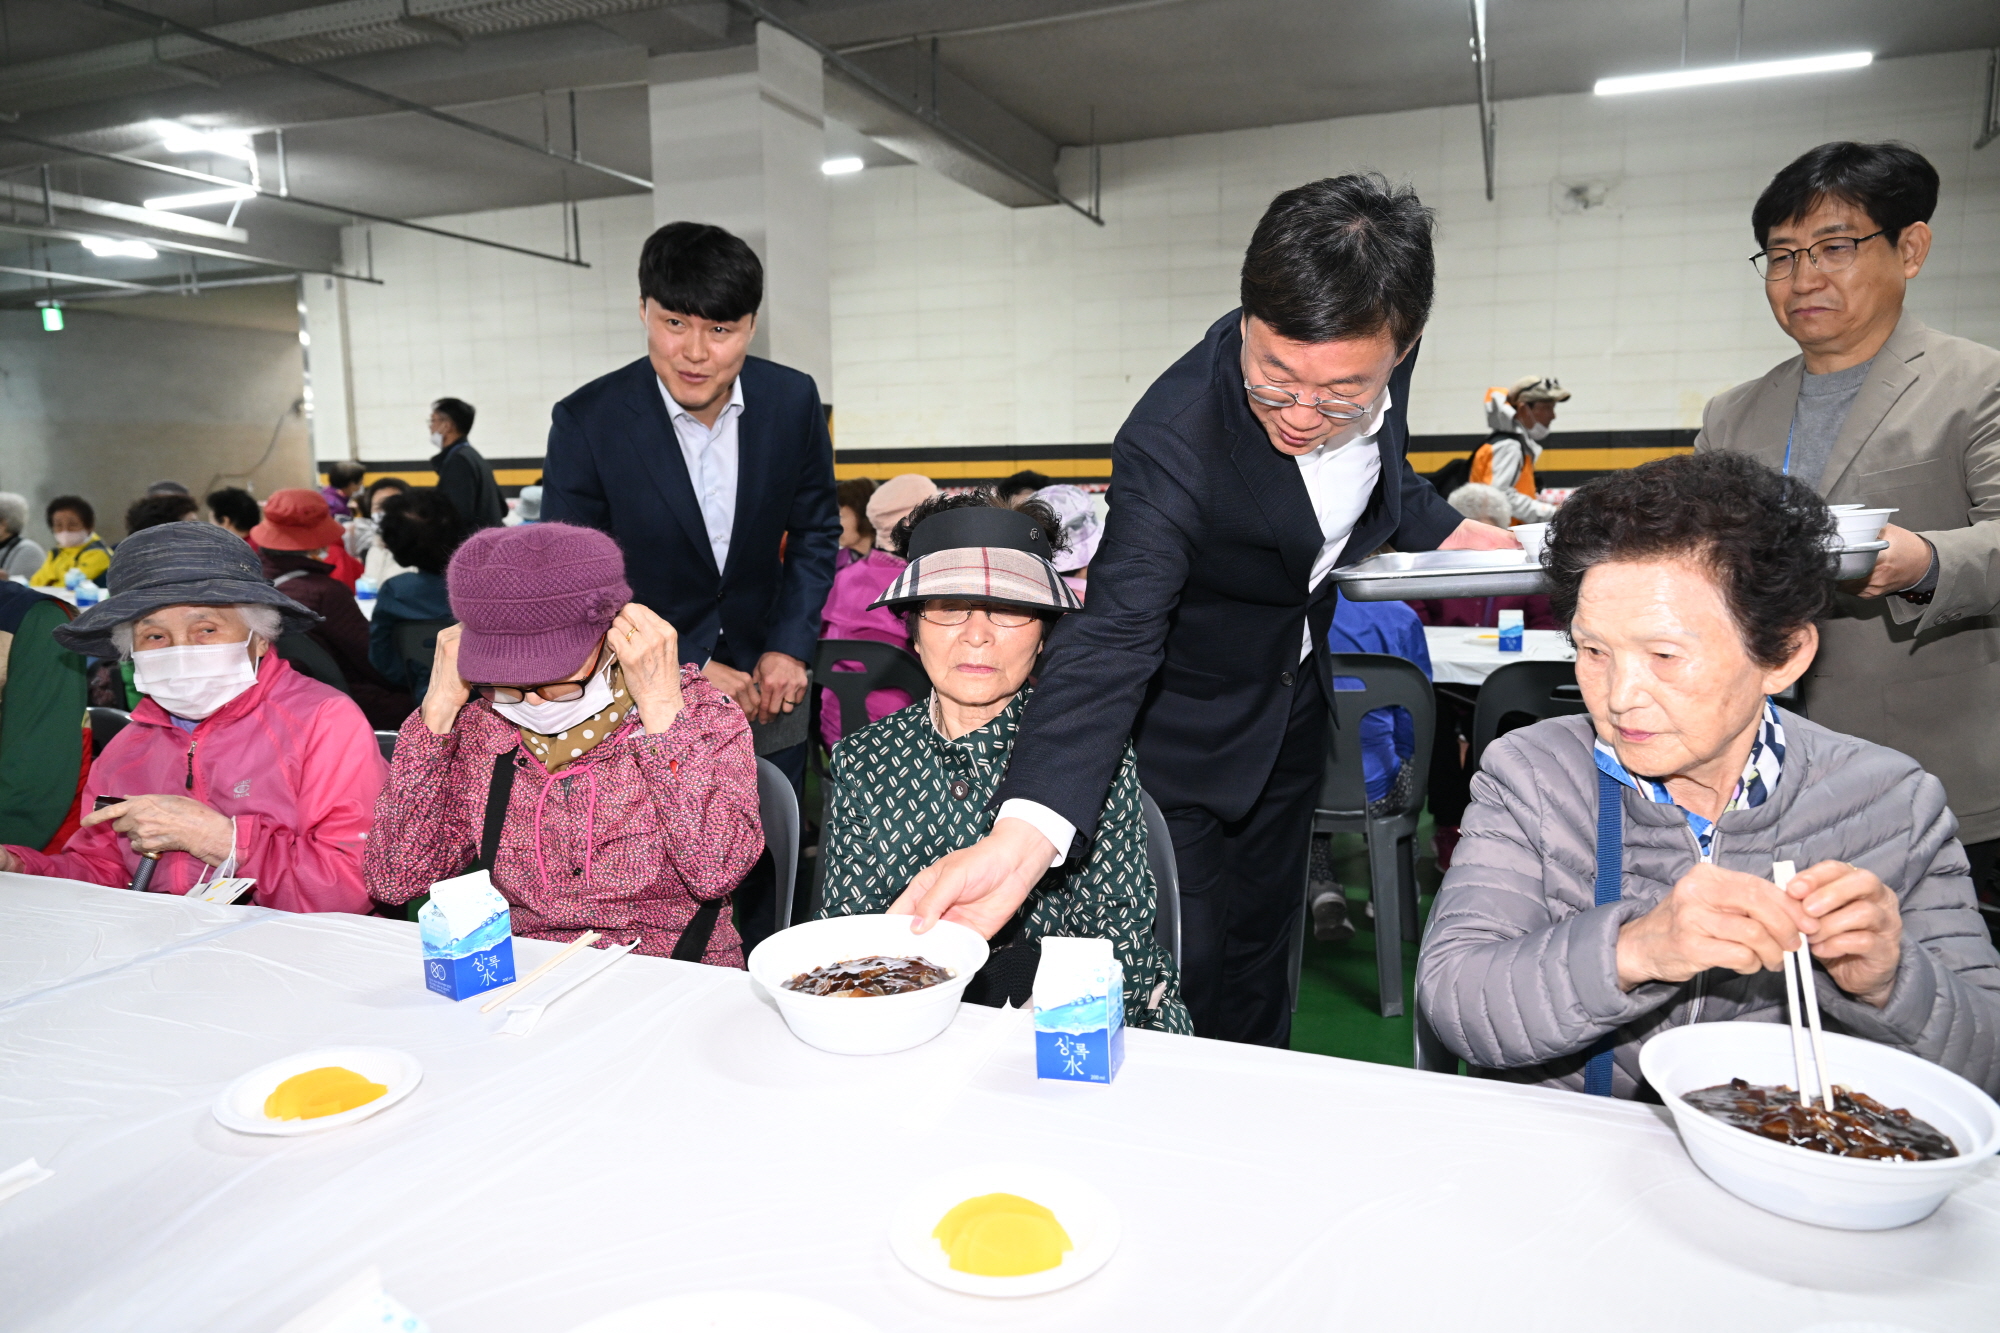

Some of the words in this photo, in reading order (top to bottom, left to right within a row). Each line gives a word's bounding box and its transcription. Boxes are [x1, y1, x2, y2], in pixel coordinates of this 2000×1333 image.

[471, 953, 501, 972] 상록
[479, 968, 498, 987] 水
[1054, 1034, 1091, 1061] 상록
[1062, 1054, 1085, 1077] 水
